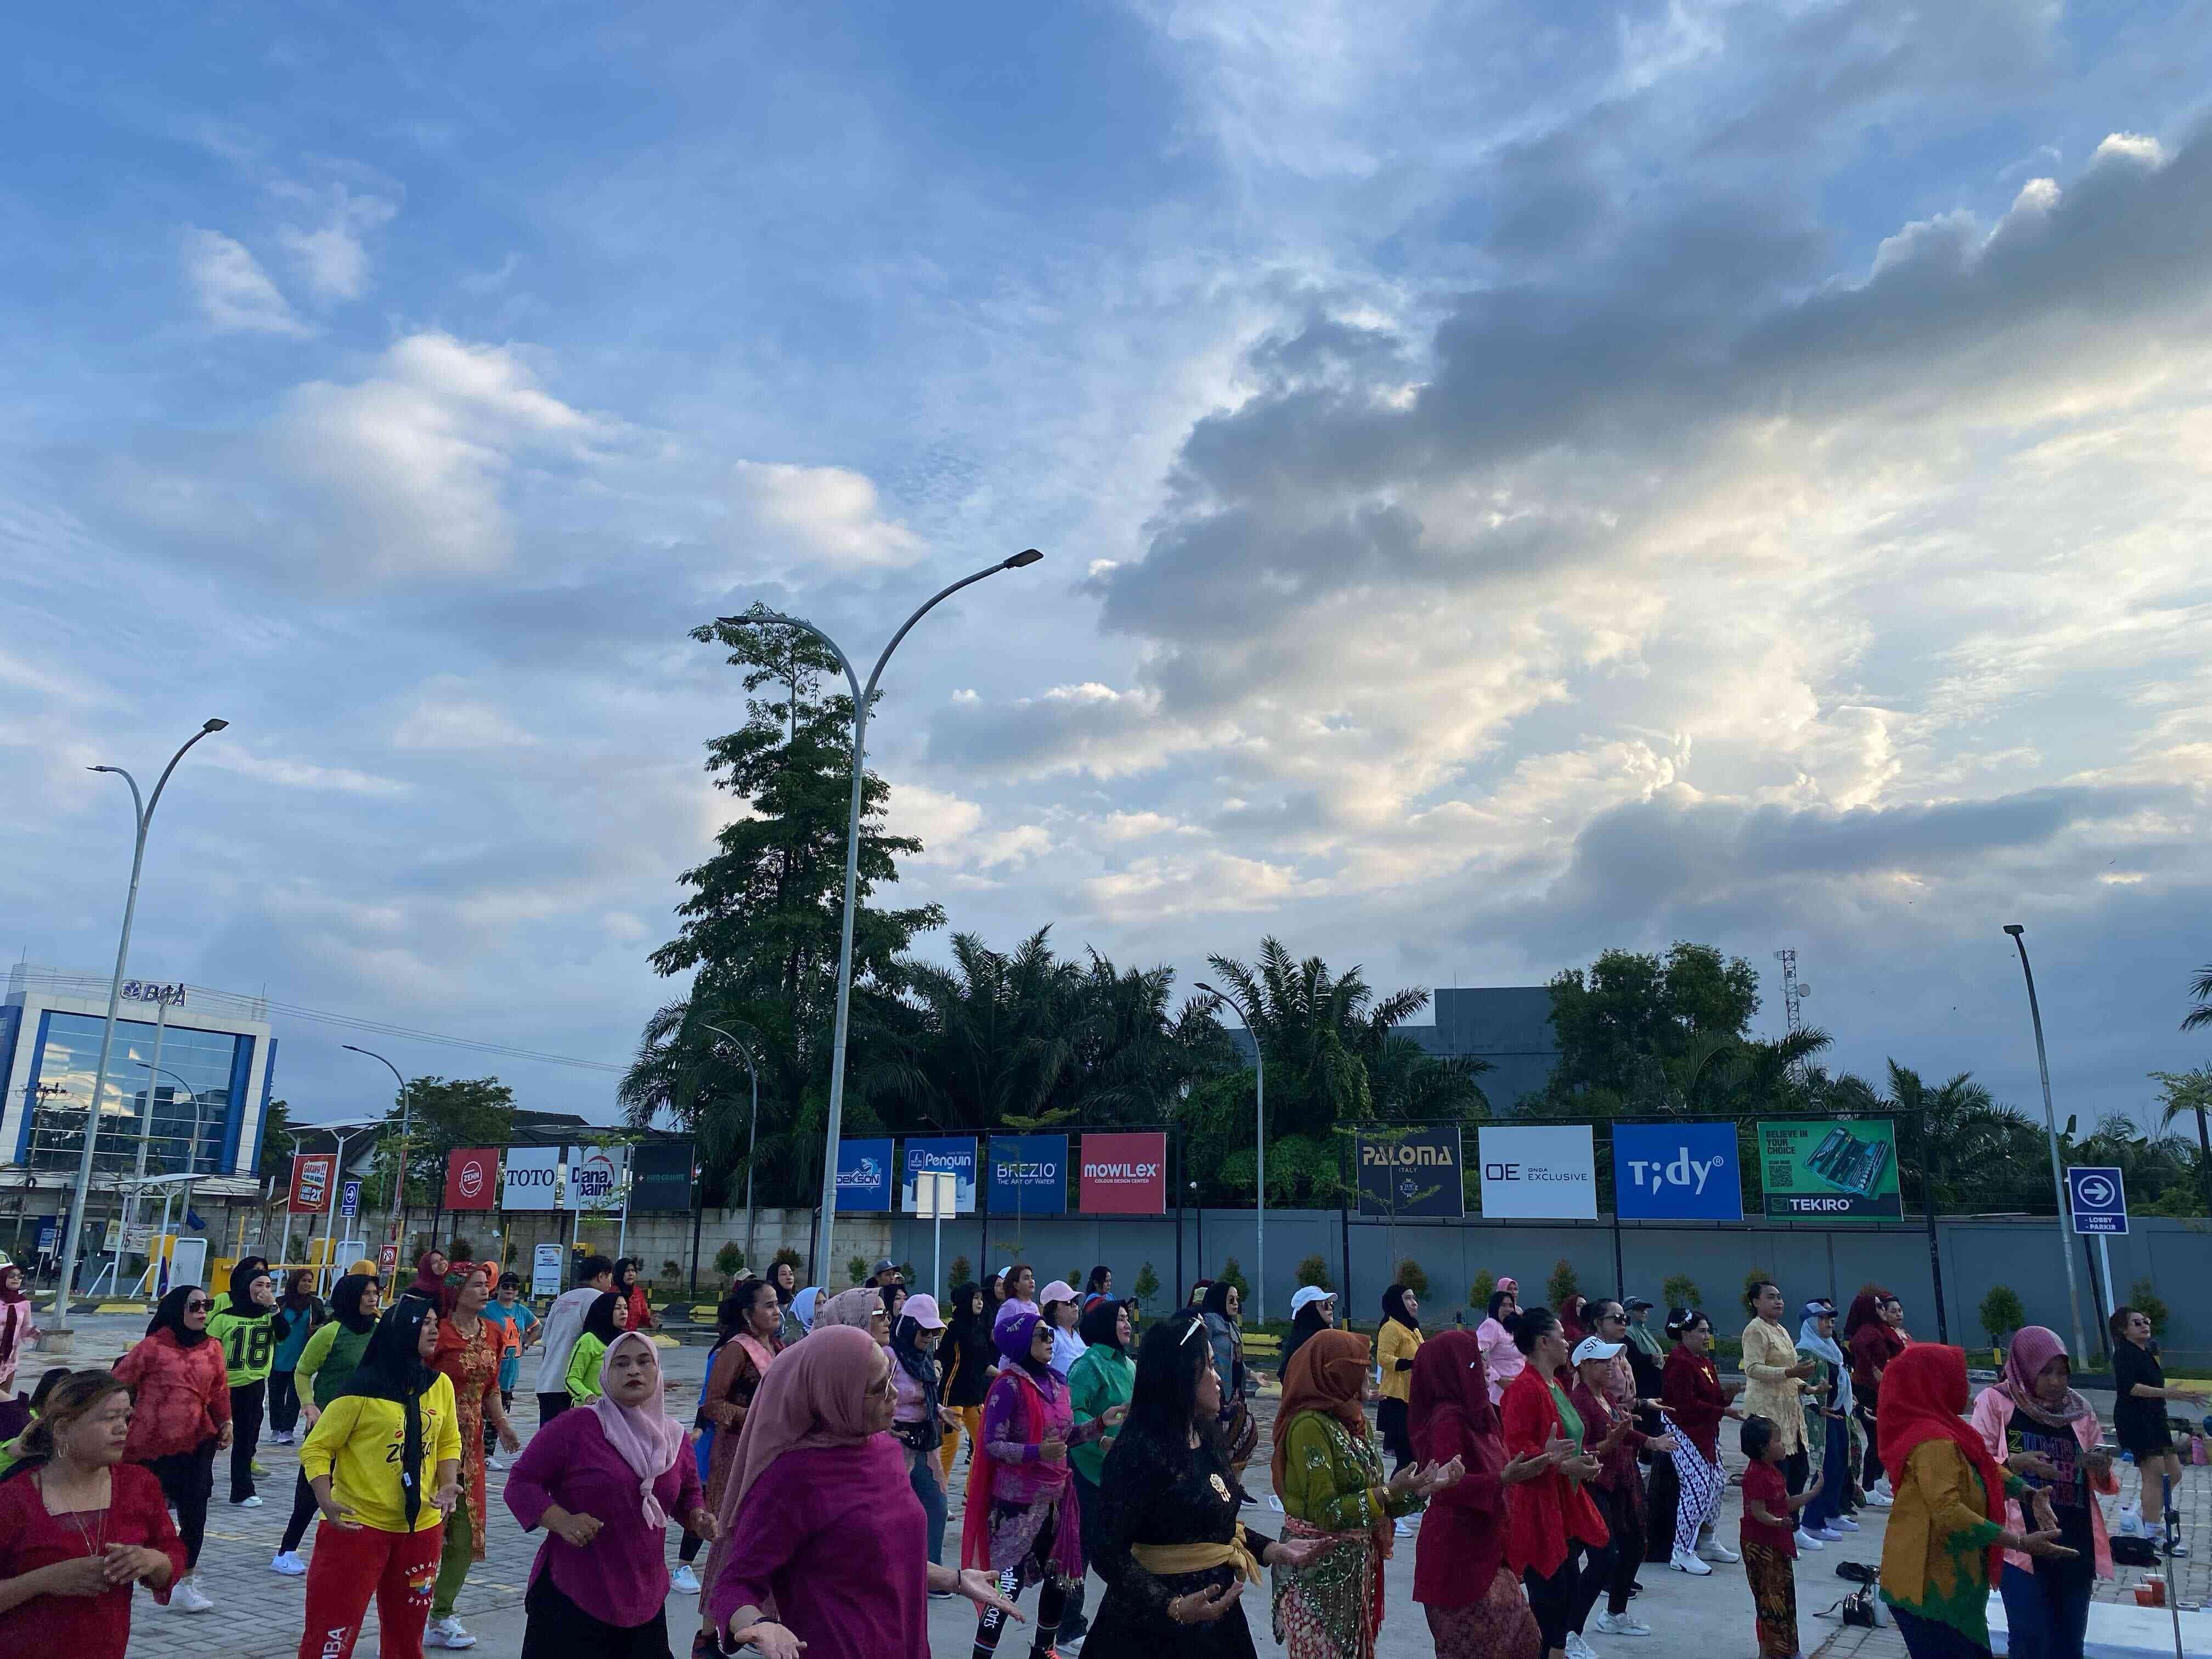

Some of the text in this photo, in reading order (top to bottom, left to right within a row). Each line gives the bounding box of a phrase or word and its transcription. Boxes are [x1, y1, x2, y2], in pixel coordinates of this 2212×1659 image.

[1363, 1146, 1453, 1165] PALOMA
[1768, 1147, 1796, 1155] CHOICE
[926, 1153, 971, 1169] Penguin
[464, 1172, 479, 1182] ZEHN
[507, 1169, 555, 1186] TOTO
[572, 1167, 608, 1183] Dana
[997, 1163, 1055, 1177] BREZIO
[1790, 1199, 1850, 1211] TEKIRO
[226, 1325, 274, 1370] 18
[405, 1564, 425, 1576] FOR
[1001, 1566, 1018, 1593] ealth
[984, 1606, 1000, 1629] orts
